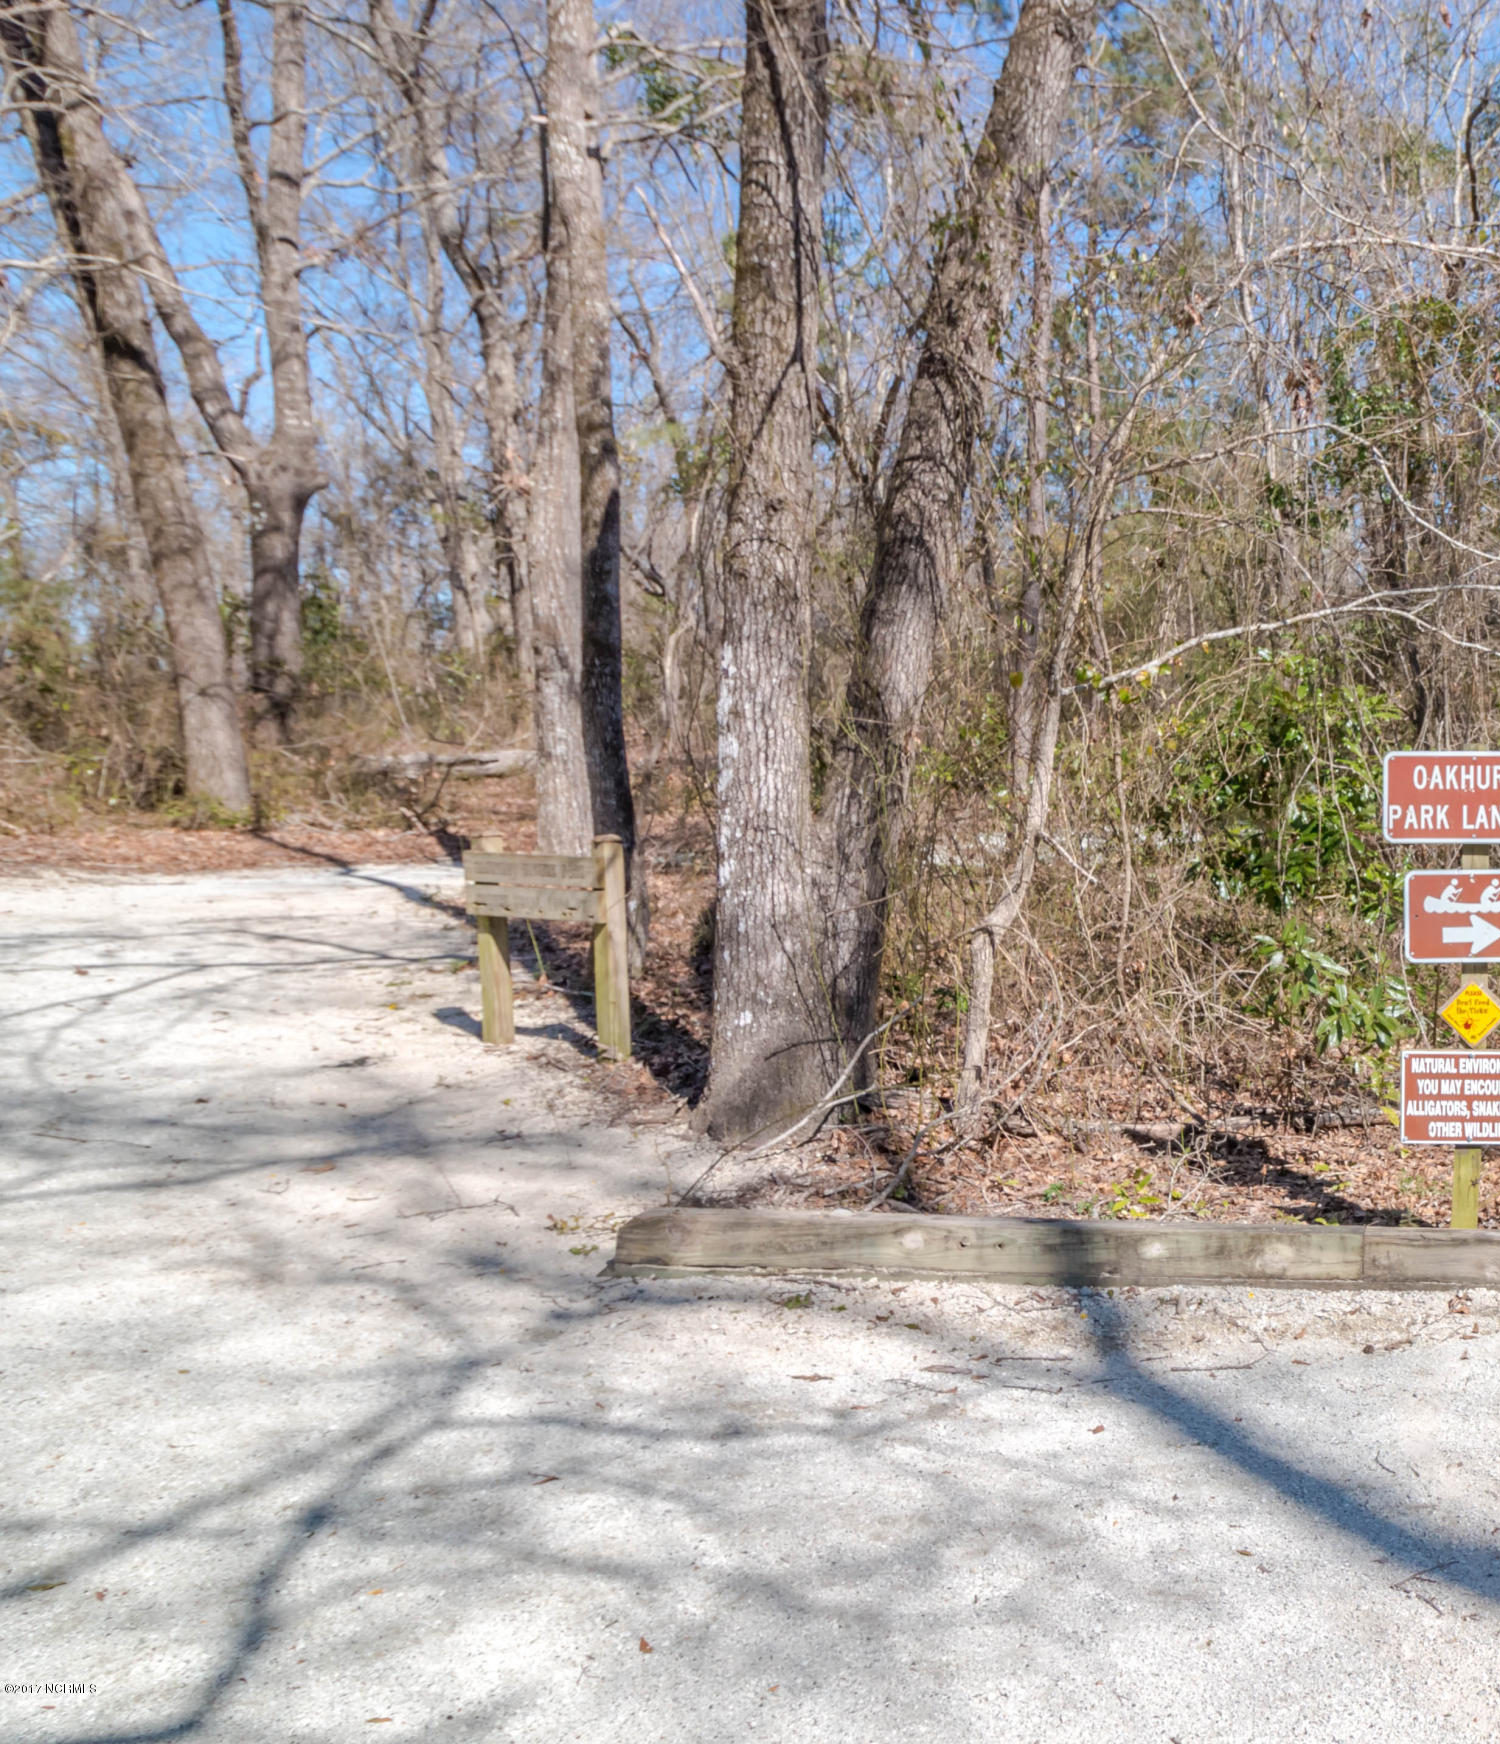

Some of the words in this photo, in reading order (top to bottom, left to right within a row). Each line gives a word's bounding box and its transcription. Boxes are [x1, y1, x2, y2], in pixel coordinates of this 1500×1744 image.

[1388, 804, 1449, 829] PARK
[1411, 1057, 1457, 1073] NATURAL
[1417, 1079, 1438, 1095] YOU
[1440, 1079, 1463, 1095] MAY
[1406, 1100, 1470, 1119] ALLIGATORS,
[1428, 1121, 1462, 1137] OTHER
